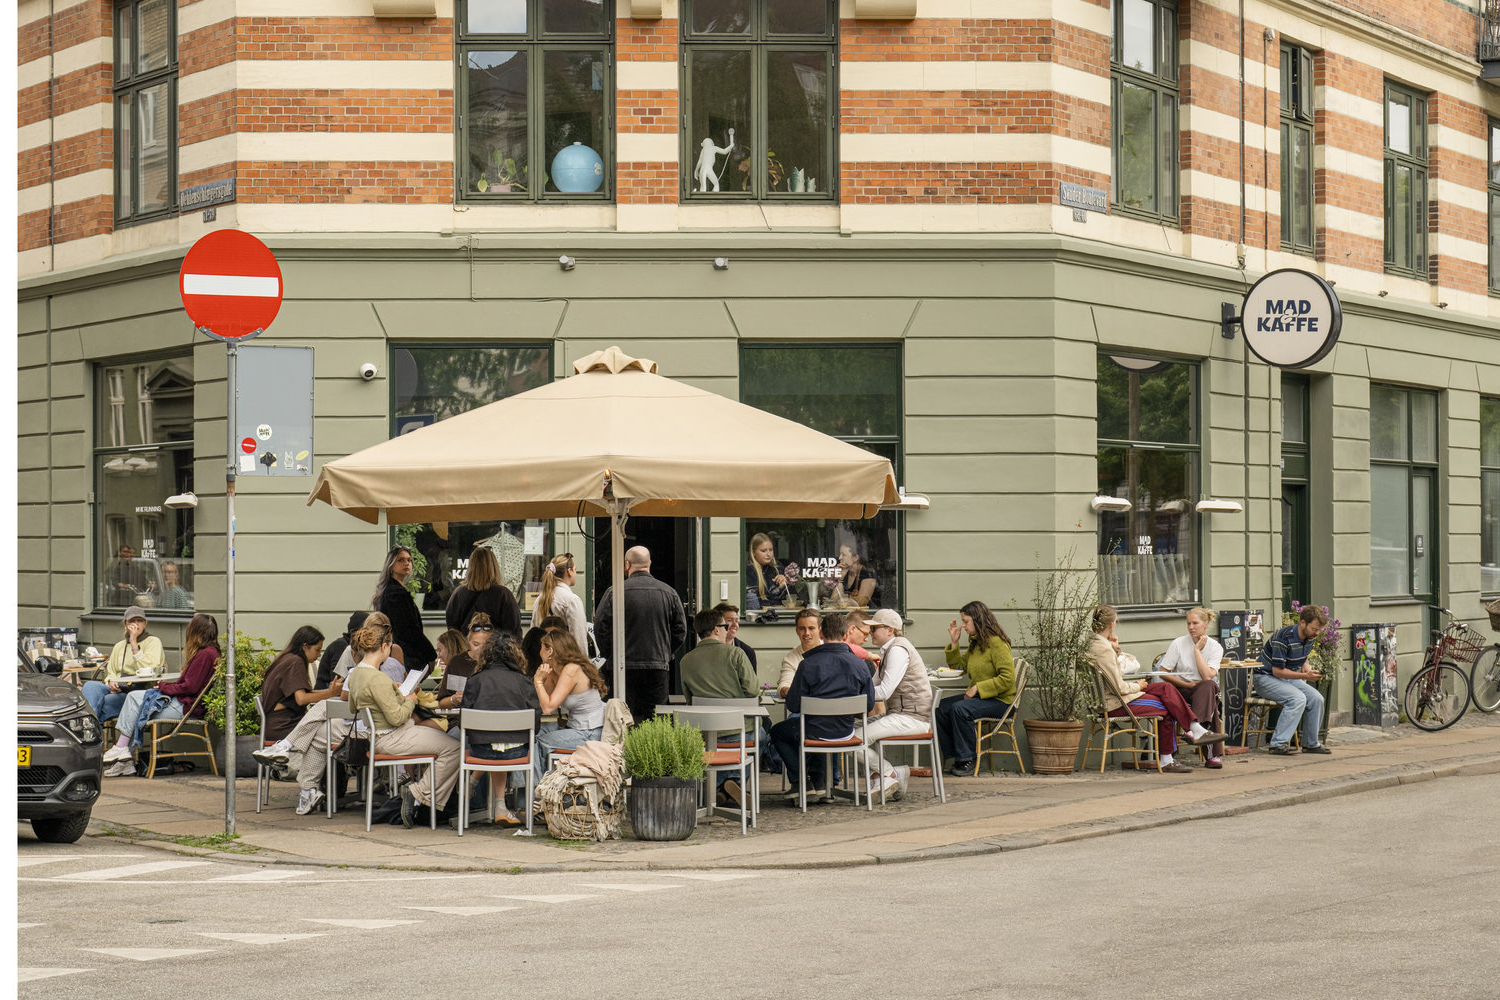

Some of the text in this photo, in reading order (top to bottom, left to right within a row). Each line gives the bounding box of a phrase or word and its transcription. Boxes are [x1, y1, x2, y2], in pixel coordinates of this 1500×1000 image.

[1266, 300, 1311, 314] MAD
[1257, 317, 1318, 332] KAFFE
[807, 557, 837, 567] MAD
[802, 568, 842, 578] KAFFE
[17, 749, 27, 763] 3
